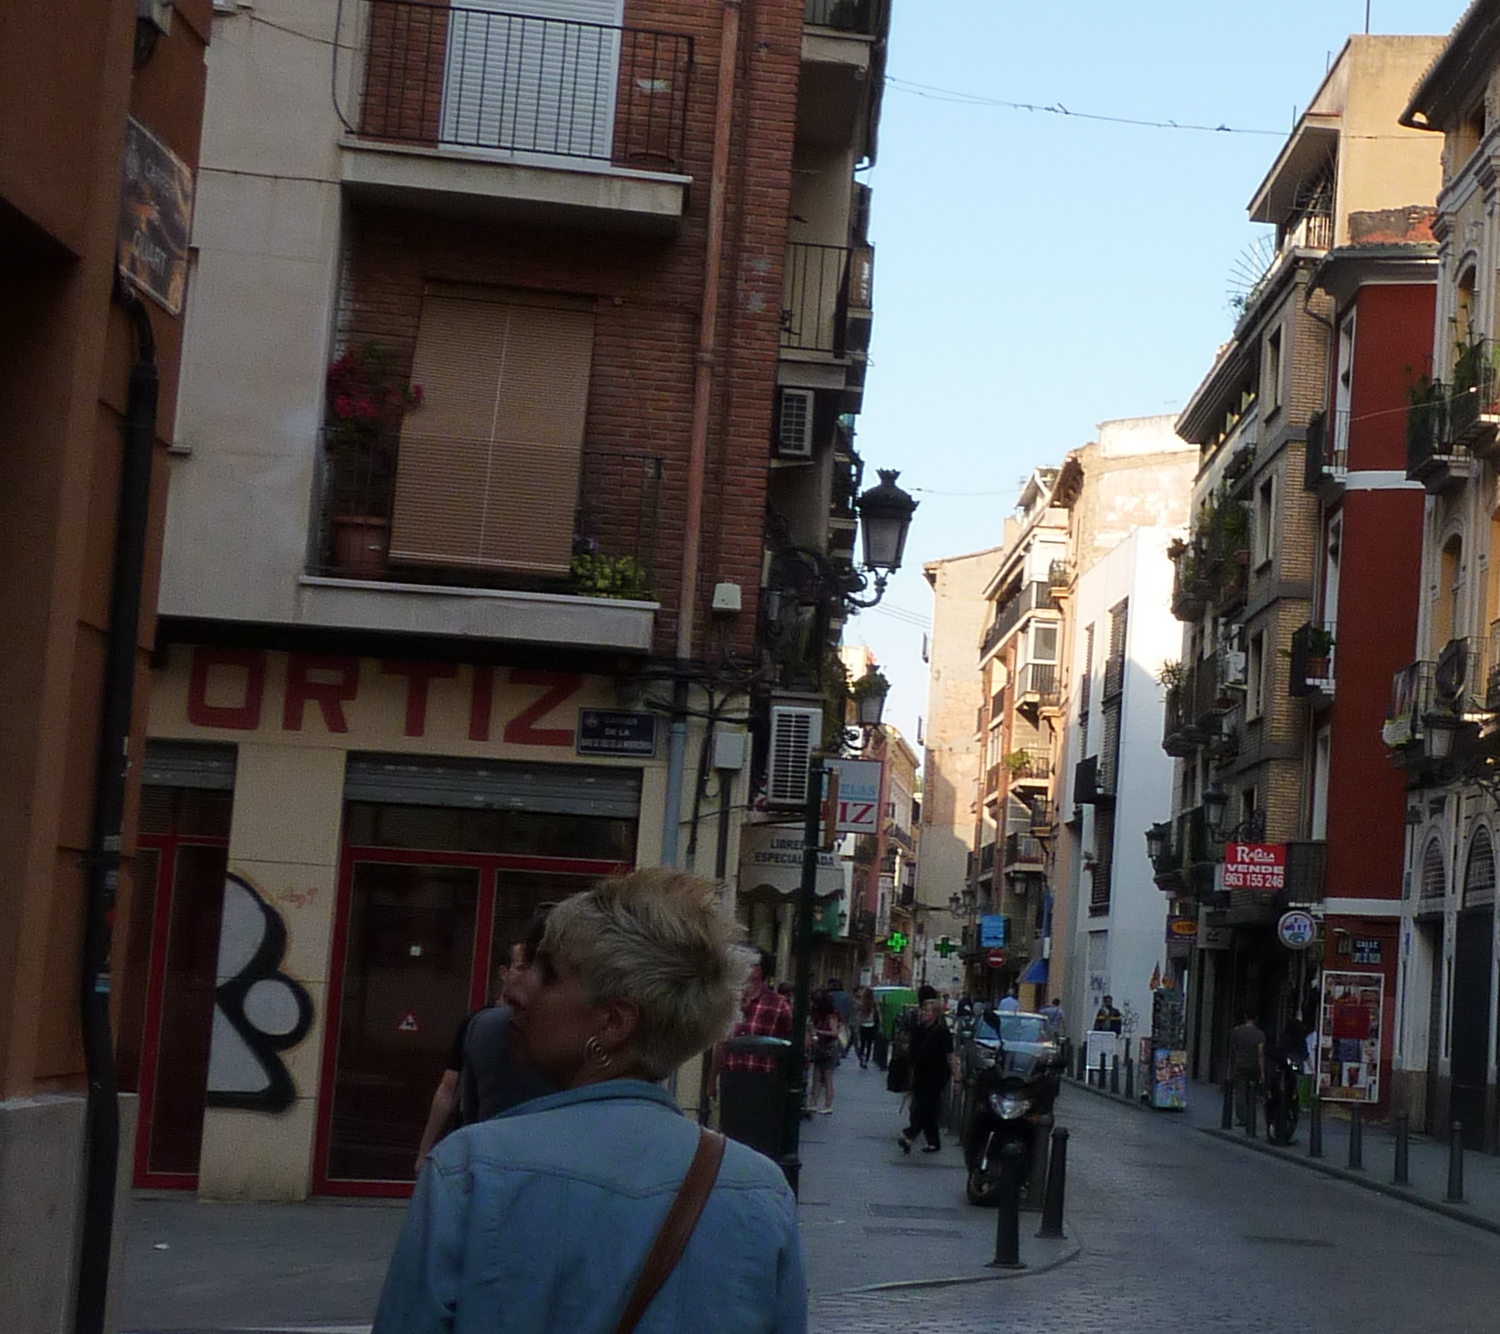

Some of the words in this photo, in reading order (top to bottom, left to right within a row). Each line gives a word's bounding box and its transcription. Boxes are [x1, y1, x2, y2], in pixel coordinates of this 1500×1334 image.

[188, 645, 584, 748] ORTIZ
[618, 728, 631, 737] LA
[770, 838, 806, 850] LIBRE
[755, 851, 835, 866] ESPECIALDA
[1226, 863, 1285, 875] VENDE
[1225, 872, 1244, 886] 963
[1246, 873, 1263, 888] 155
[1265, 874, 1284, 889] 246
